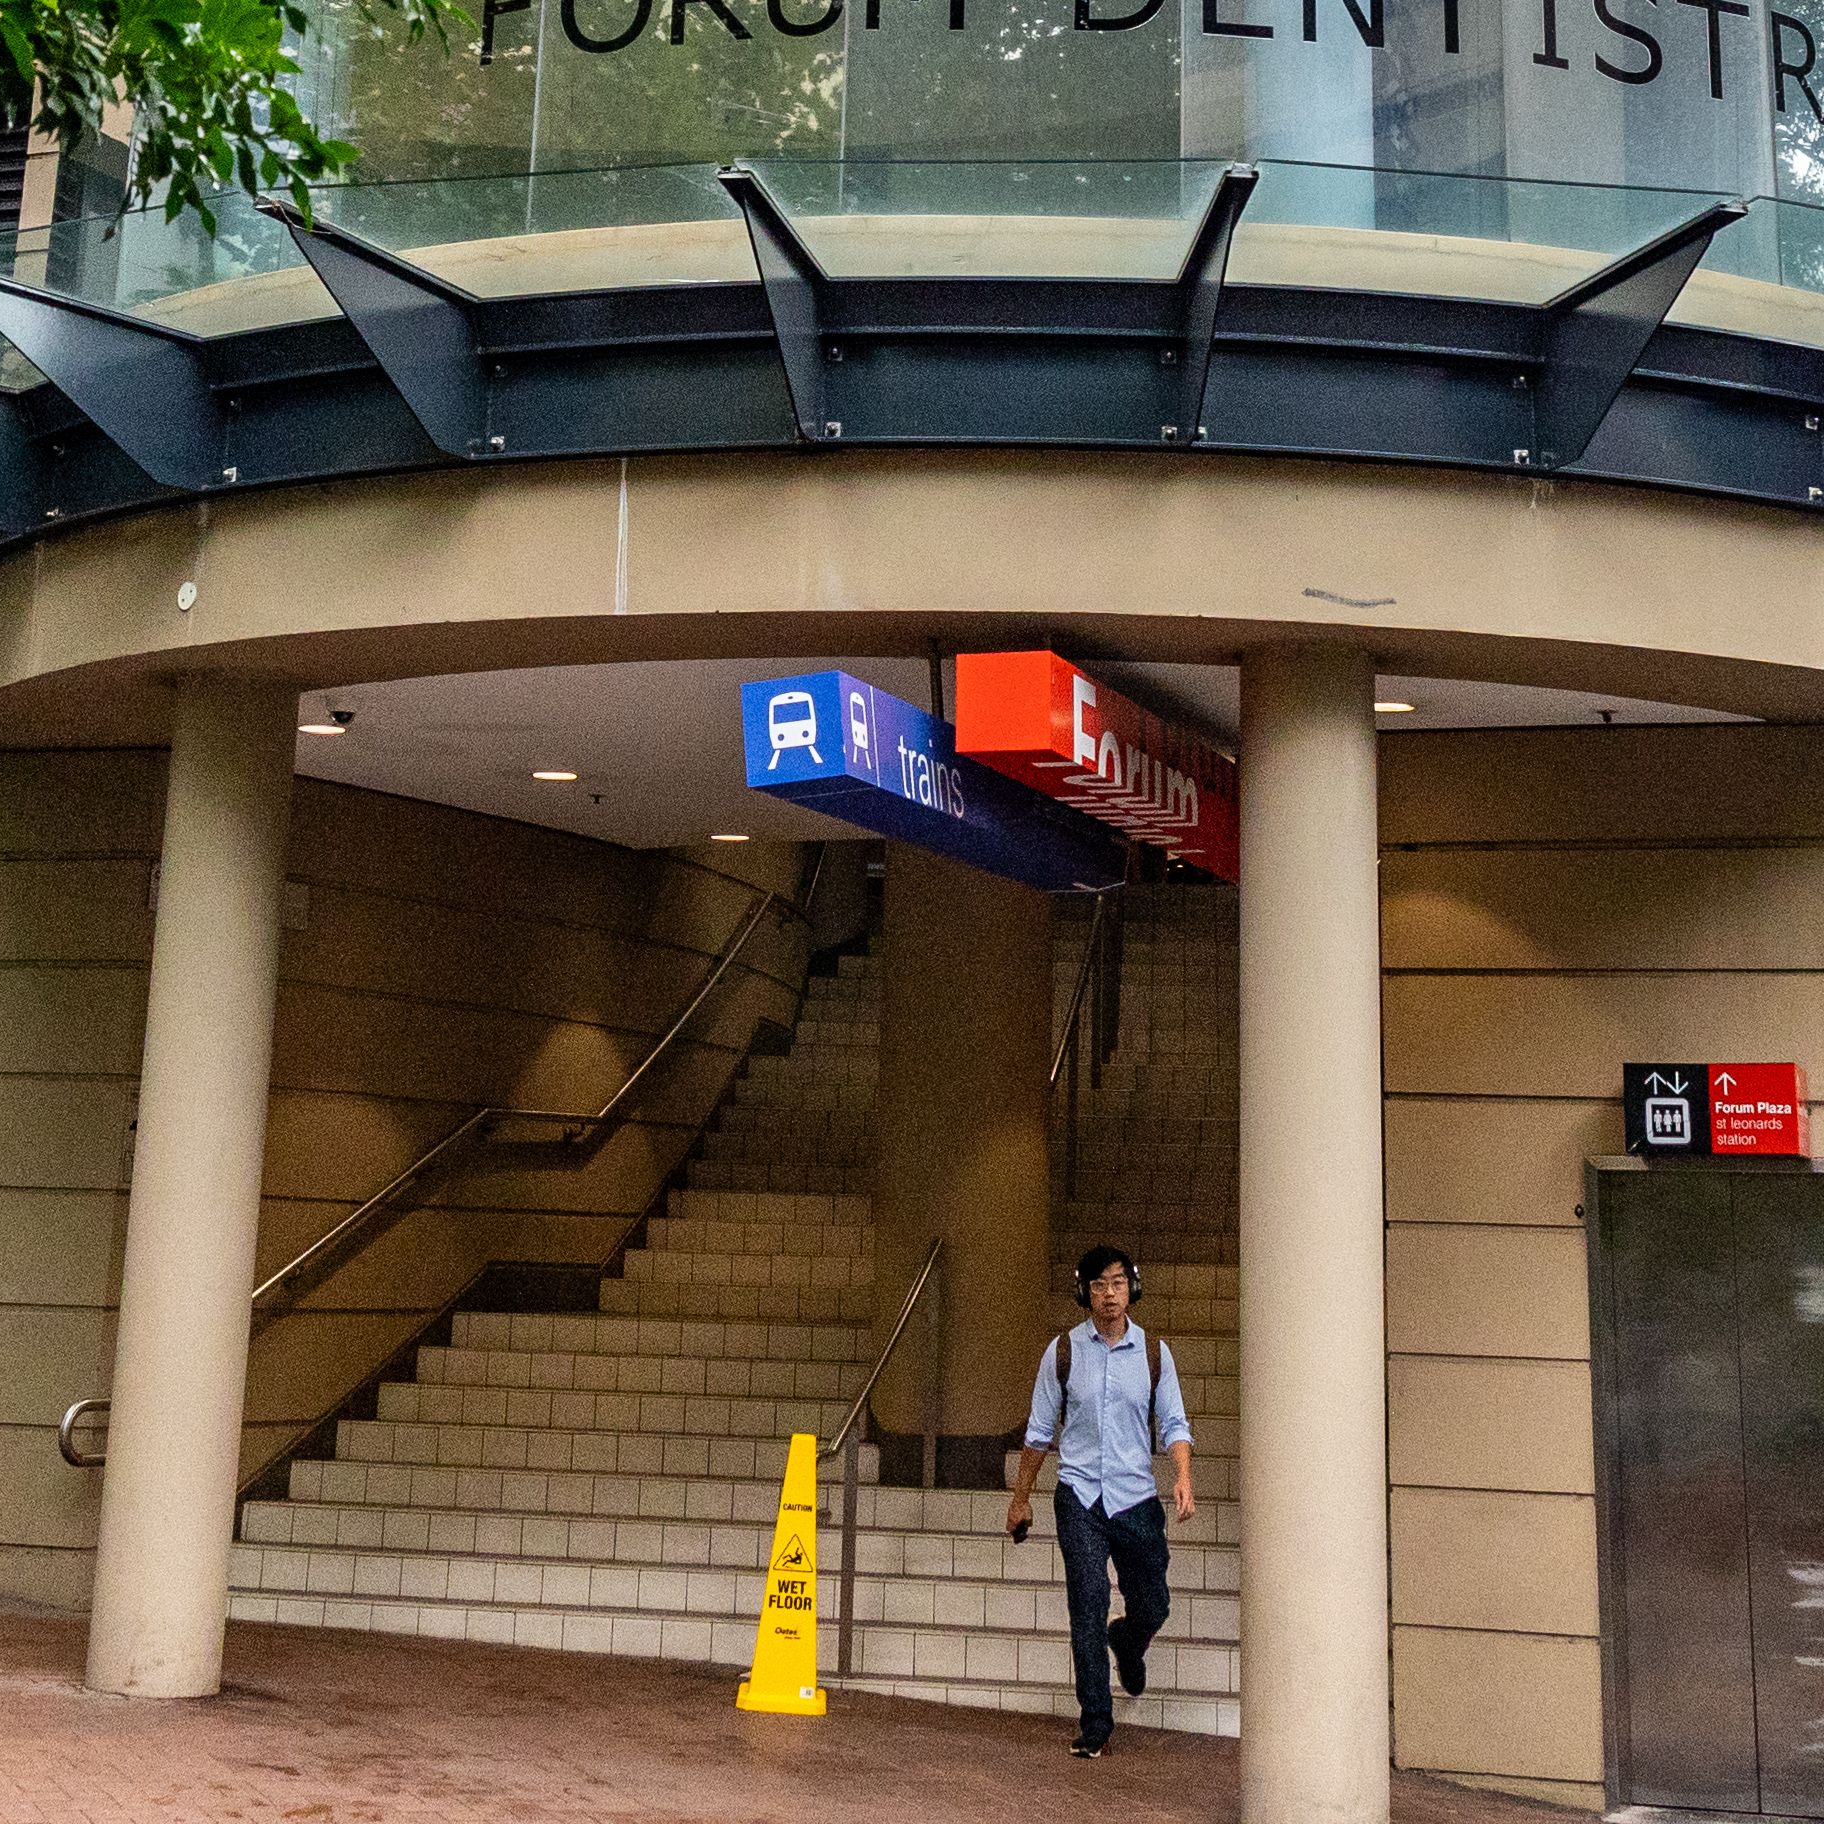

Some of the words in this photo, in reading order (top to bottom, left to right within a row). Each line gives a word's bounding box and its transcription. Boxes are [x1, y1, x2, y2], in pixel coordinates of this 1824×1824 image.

[1033, 673, 1199, 827] Forum
[897, 734, 964, 818] trains
[1715, 1102, 1754, 1114] Forum
[1757, 1102, 1792, 1114] Plaza
[1716, 1118, 1727, 1129] st
[1731, 1117, 1783, 1130] leonards
[1717, 1133, 1757, 1145] station
[783, 1503, 813, 1512] CAUTION
[778, 1580, 807, 1594] WET
[769, 1594, 812, 1611] FLOOR
